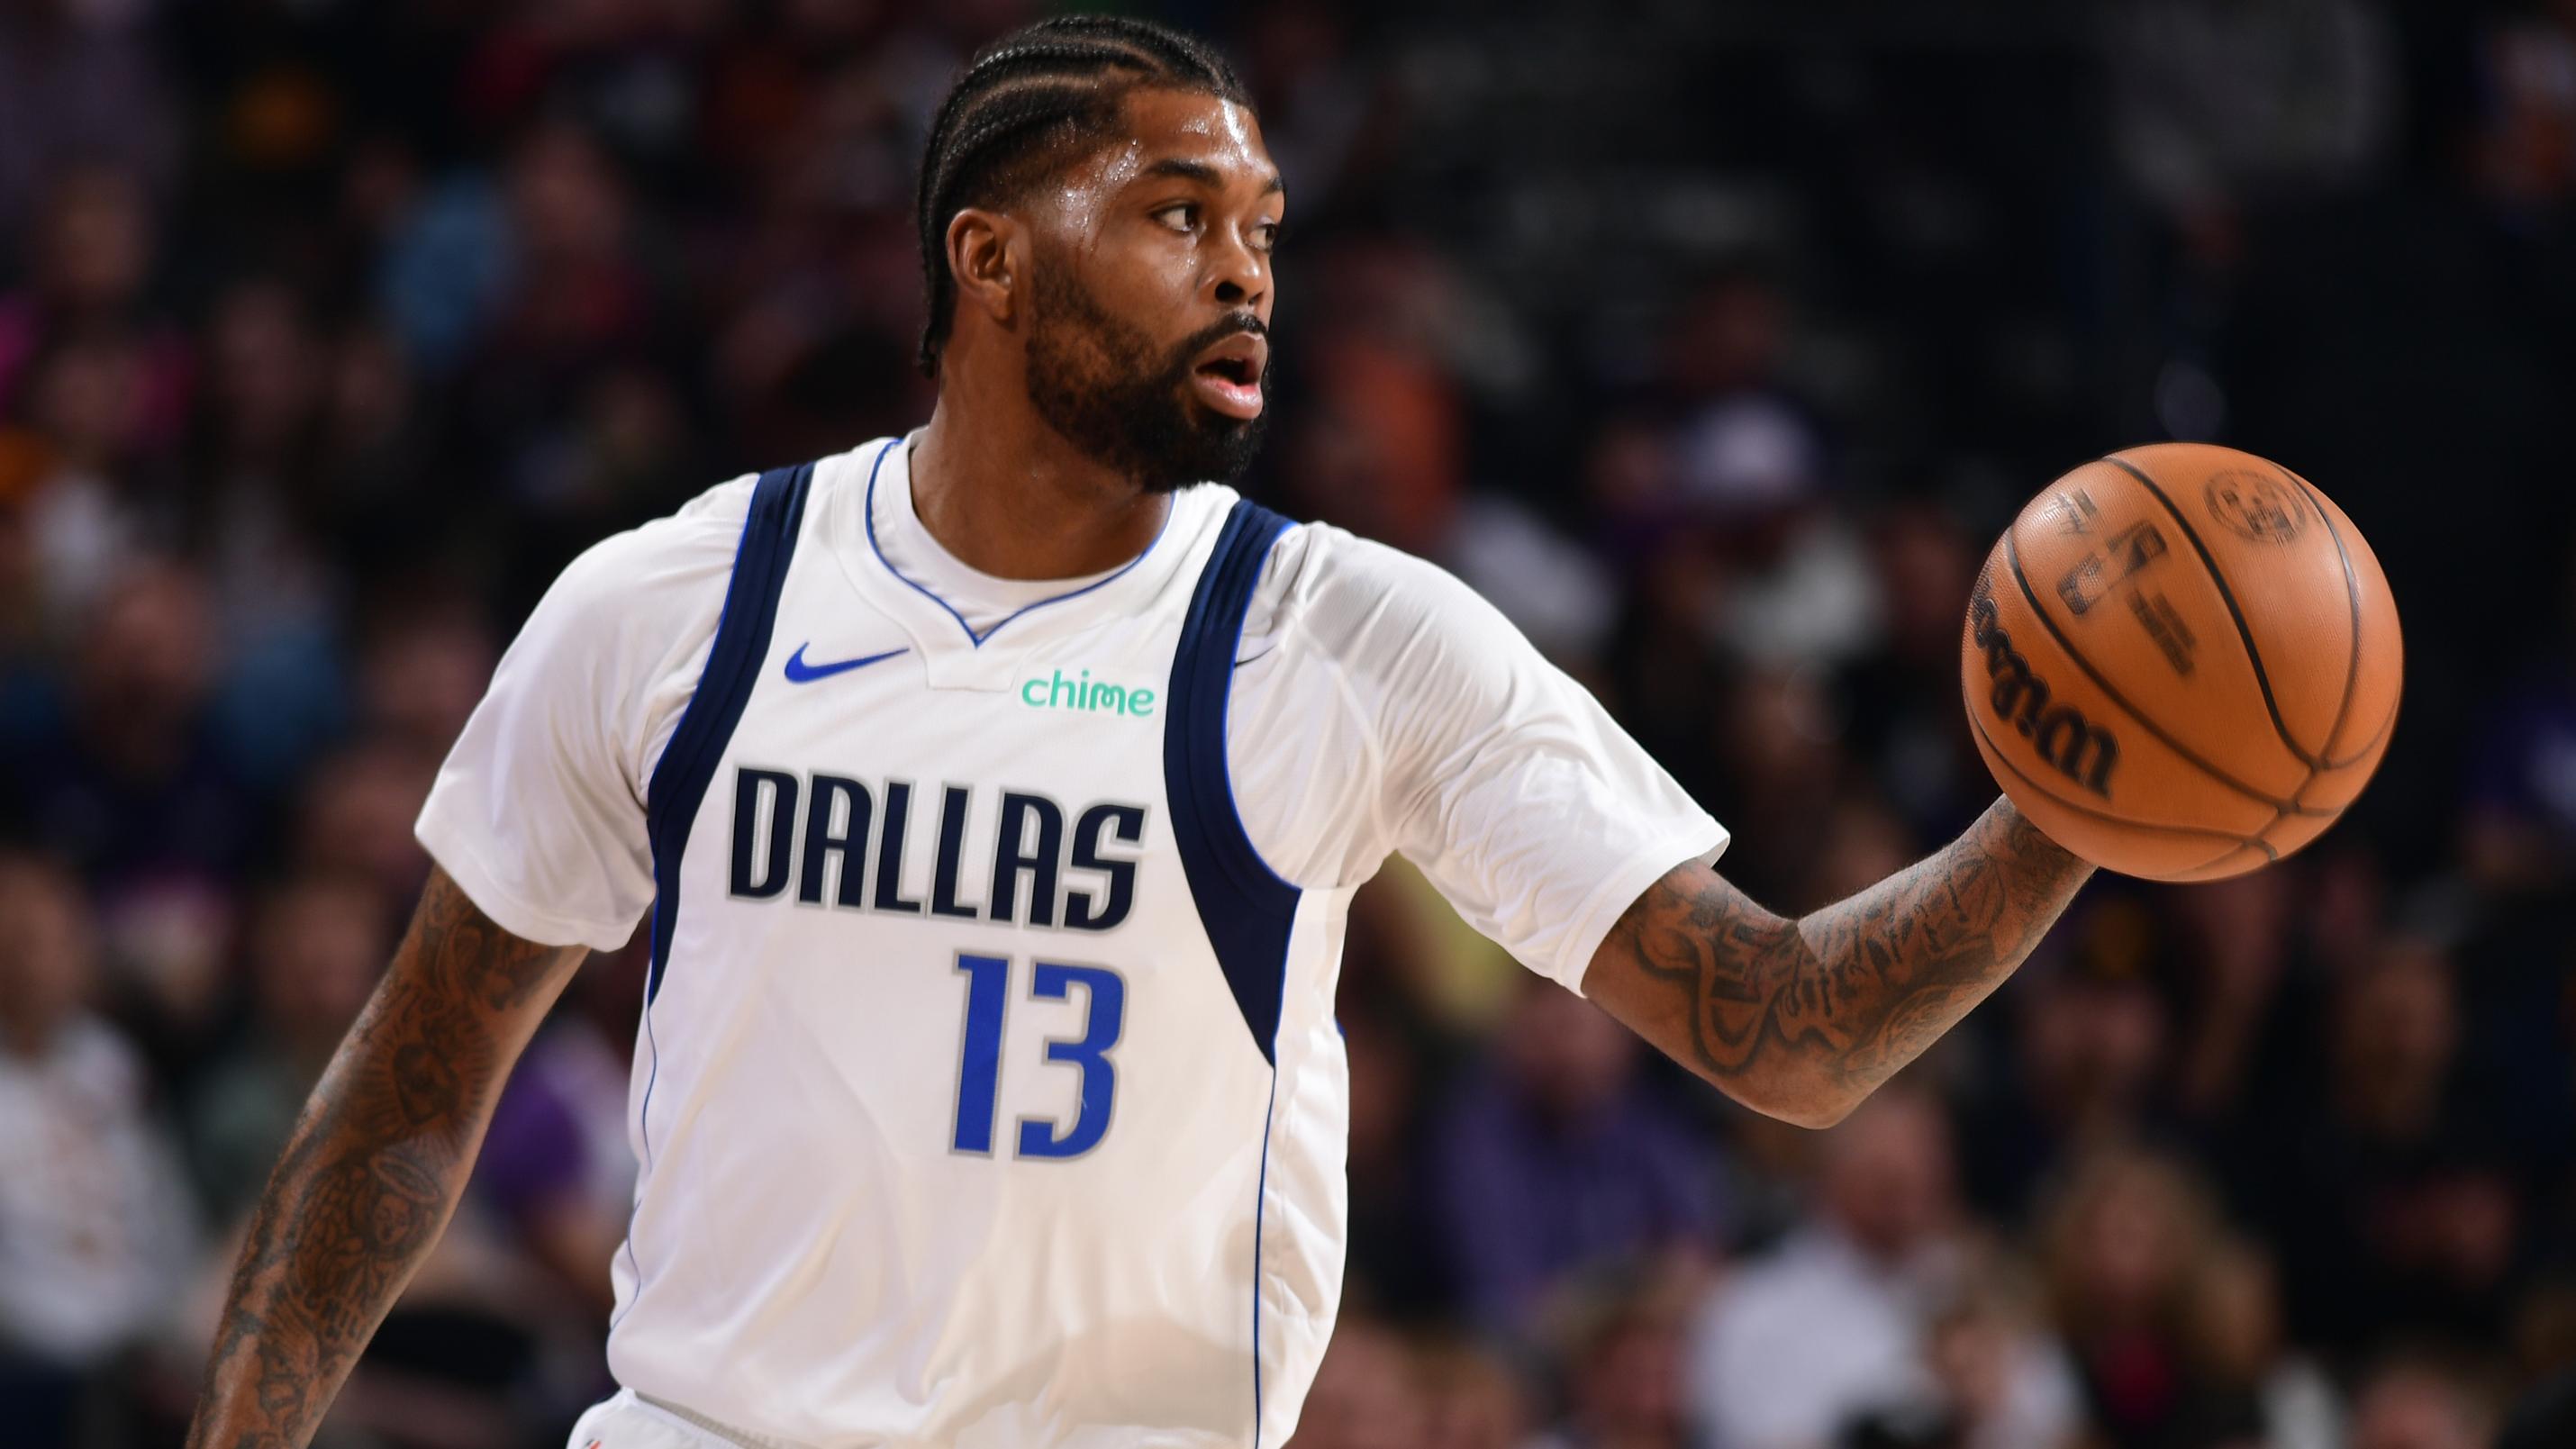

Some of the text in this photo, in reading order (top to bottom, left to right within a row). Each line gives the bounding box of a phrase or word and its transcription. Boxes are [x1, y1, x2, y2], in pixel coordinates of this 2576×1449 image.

[1021, 669, 1155, 717] chime
[727, 765, 1149, 935] DALLAS
[948, 949, 1128, 1162] 13
